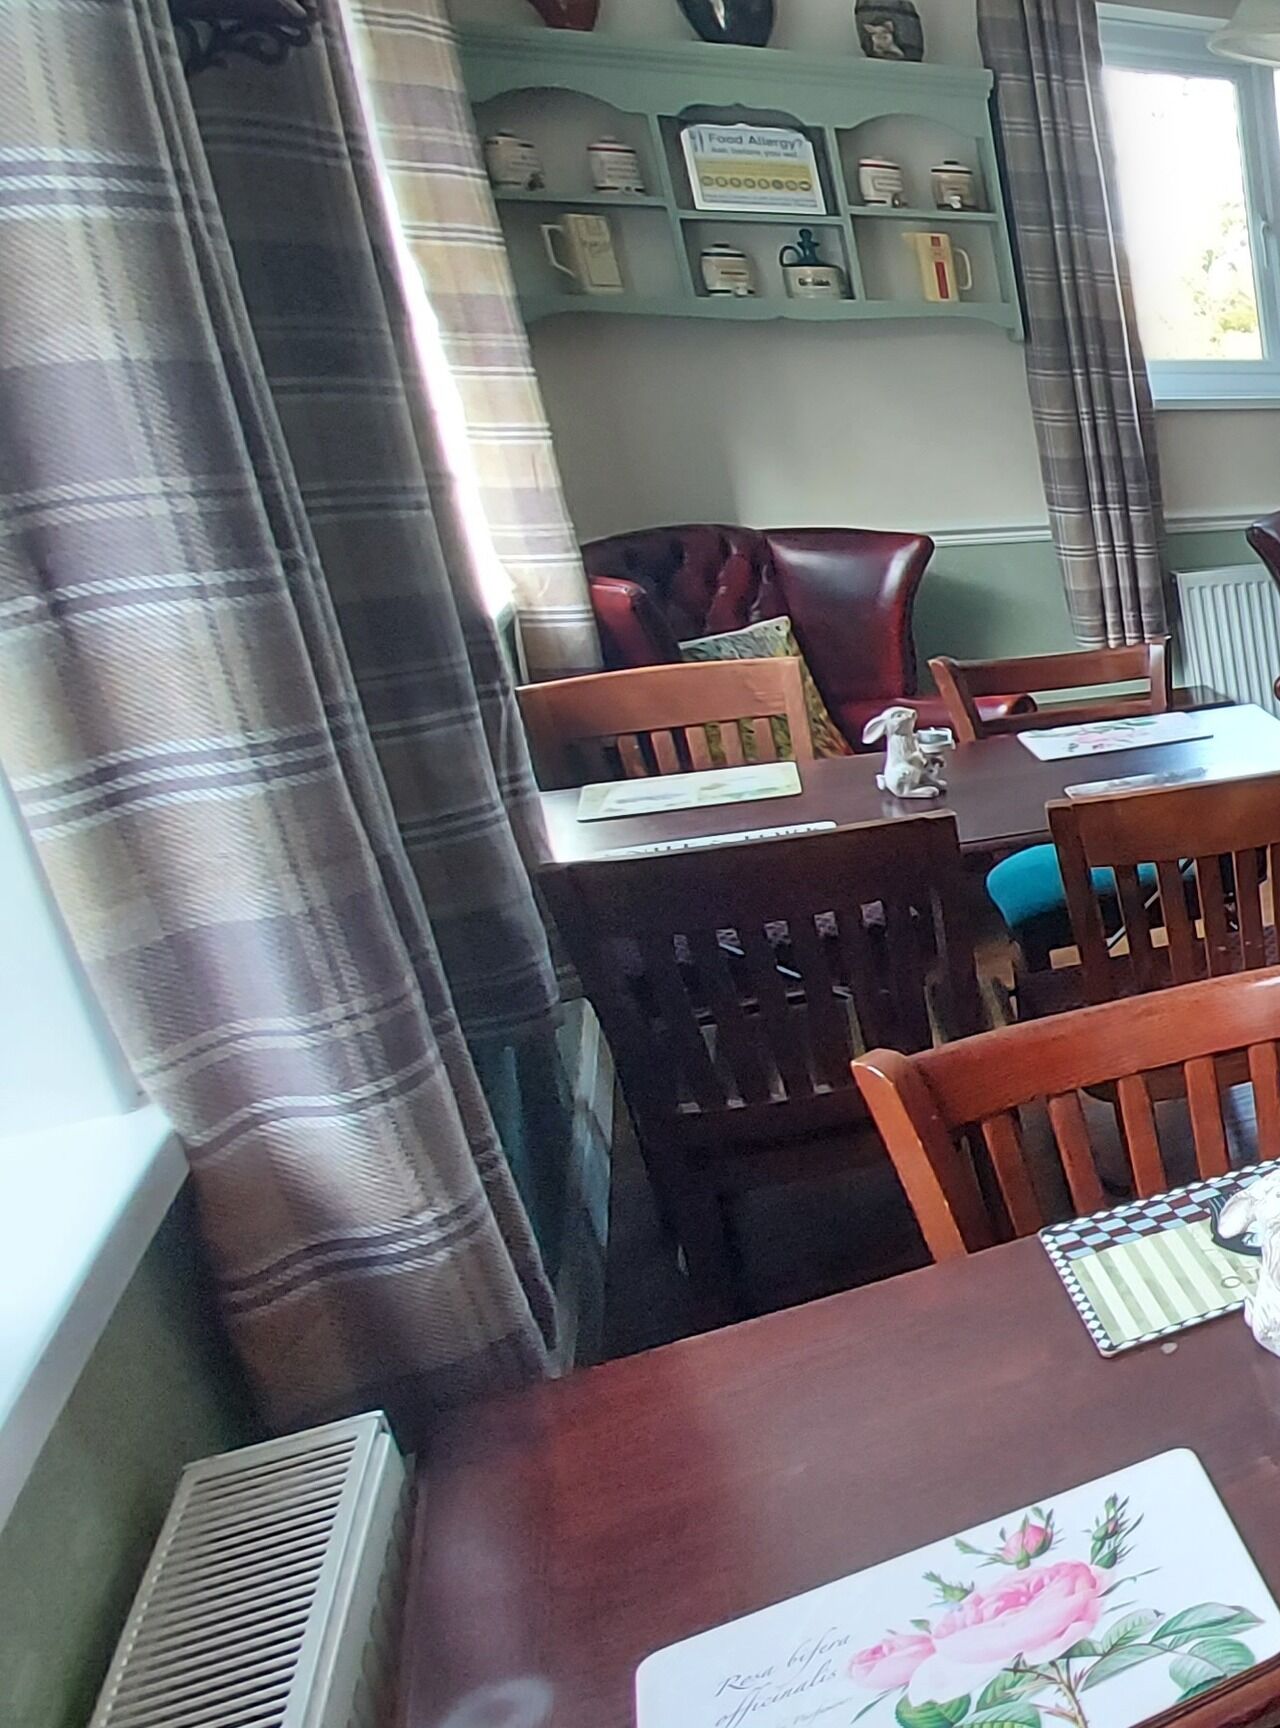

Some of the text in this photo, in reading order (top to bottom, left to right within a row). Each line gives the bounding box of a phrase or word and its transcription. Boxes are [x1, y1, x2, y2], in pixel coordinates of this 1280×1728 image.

[709, 133, 803, 150] Food Allergy?
[714, 1626, 852, 1698] Rosa bifera
